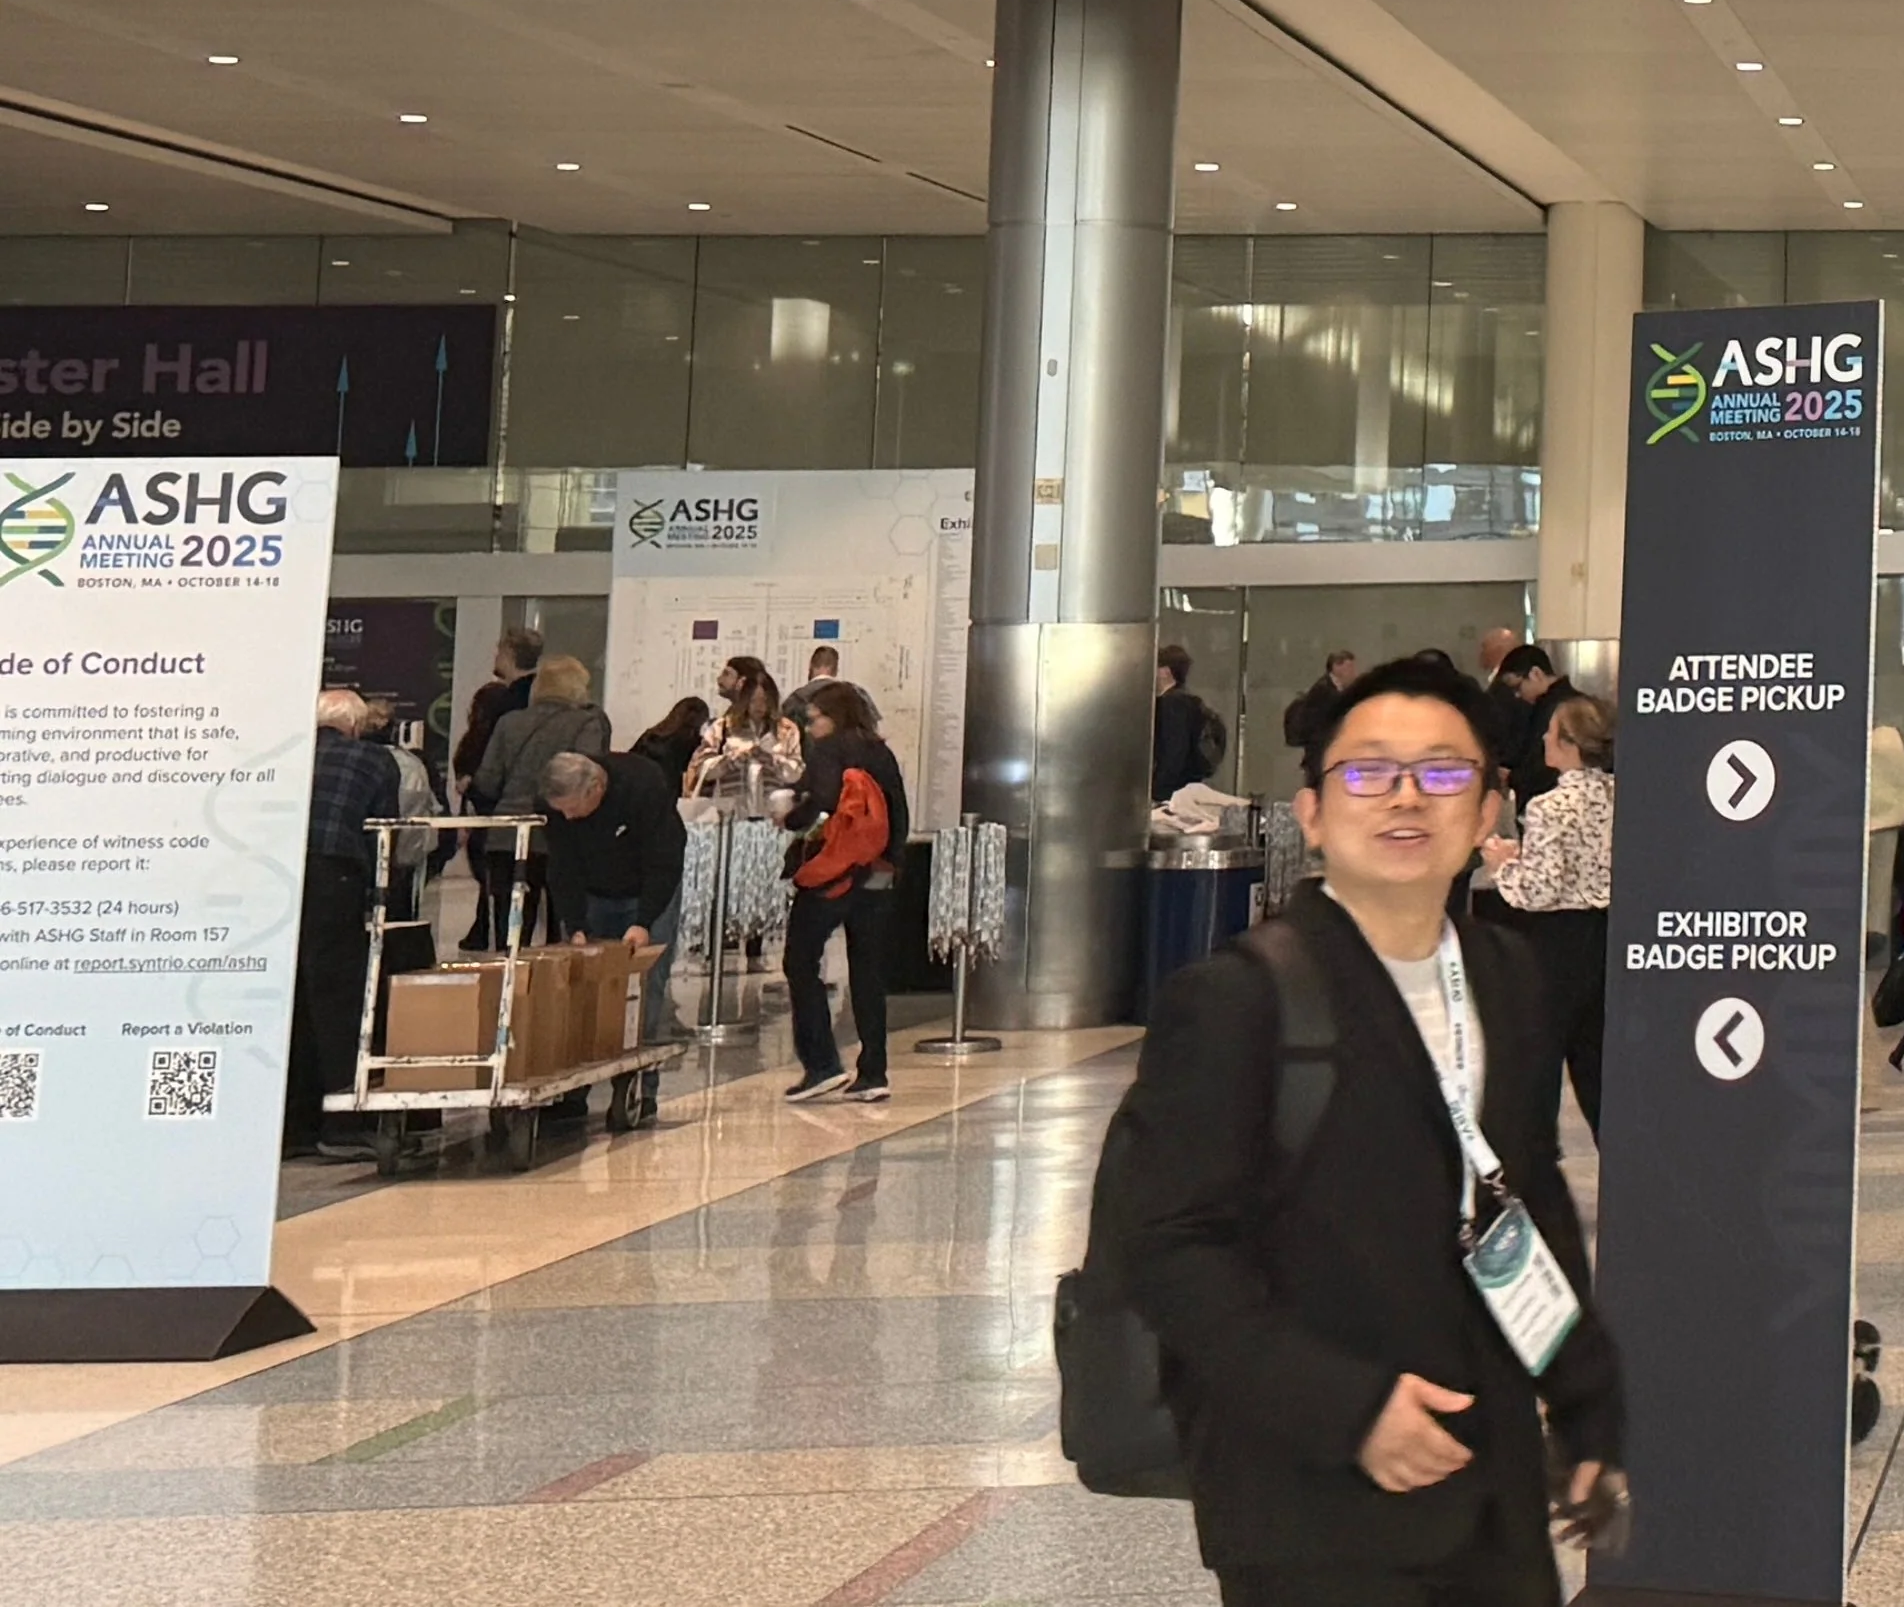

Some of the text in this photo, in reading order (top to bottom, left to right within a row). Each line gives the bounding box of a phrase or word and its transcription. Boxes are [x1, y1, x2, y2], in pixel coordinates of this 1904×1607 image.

[0, 339, 268, 395] ster Hall
[1712, 333, 1862, 388] ASHG
[1711, 389, 1862, 421] ANNUAL 2025
[1710, 408, 1781, 425] MEETING
[0, 410, 182, 446] ide by Side
[84, 471, 289, 526] ASHG
[669, 498, 759, 522] ASHG
[712, 525, 758, 540] 2025
[80, 552, 174, 568] MEETING
[81, 534, 282, 567] ANNUAL 2025
[77, 577, 136, 590] BOSTON,
[140, 577, 163, 588] MA
[177, 576, 241, 588] OCTOBER
[326, 619, 363, 633] SHG
[0, 651, 206, 676] de of Conduct
[1668, 653, 1814, 682] ATTENDEE
[1637, 684, 1847, 714] BADGE PICKUP
[5, 704, 220, 722] is committed to fostering a
[41, 725, 143, 741] environment
[149, 725, 178, 740] that
[184, 725, 197, 740] is
[201, 724, 240, 742] safe,
[60, 748, 90, 763] and
[95, 747, 182, 767] productive
[187, 746, 209, 762] for
[0, 767, 276, 788] ting dialogue and discovery for all
[82, 834, 100, 850] of
[103, 834, 165, 850] witness
[169, 834, 210, 849] code
[22, 856, 77, 875] please
[81, 858, 131, 875] report
[0, 898, 180, 918] 6-517-3532 (24 hours)
[1657, 911, 1808, 938] EXHIBITOR
[0, 926, 230, 944] with ASHG Staff in Room 157
[0, 954, 268, 974] online at report.syntrio.com/ashg
[1626, 943, 1838, 971] BADGE PICKUP
[5, 1022, 87, 1037] of Conduct
[121, 1020, 254, 1039] Report a Violation
